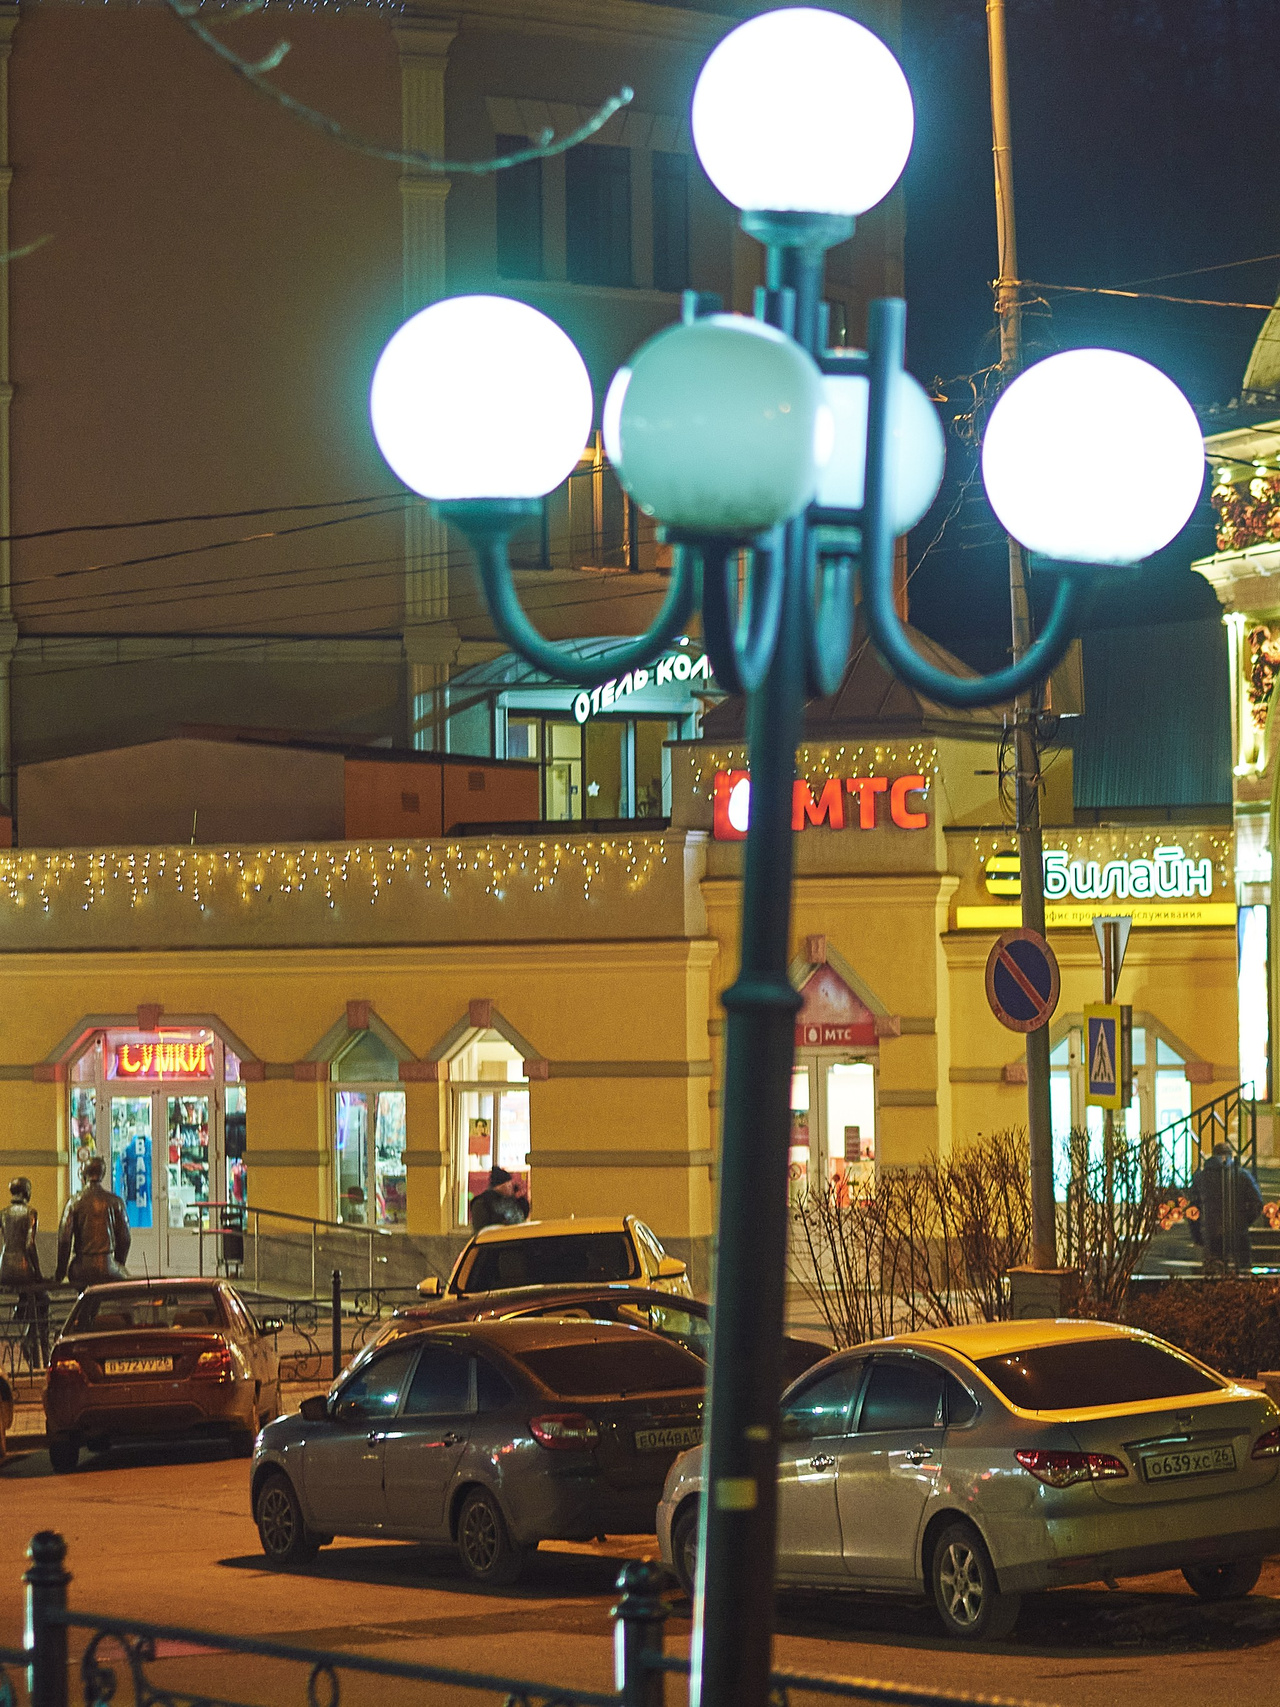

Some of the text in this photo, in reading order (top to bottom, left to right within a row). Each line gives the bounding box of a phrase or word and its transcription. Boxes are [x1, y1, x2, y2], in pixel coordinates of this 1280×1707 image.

[574, 667, 649, 724] ОТЕЛЬ
[791, 775, 928, 831] МТС
[825, 1028, 852, 1040] МТС
[122, 1043, 206, 1073] СУМКИ
